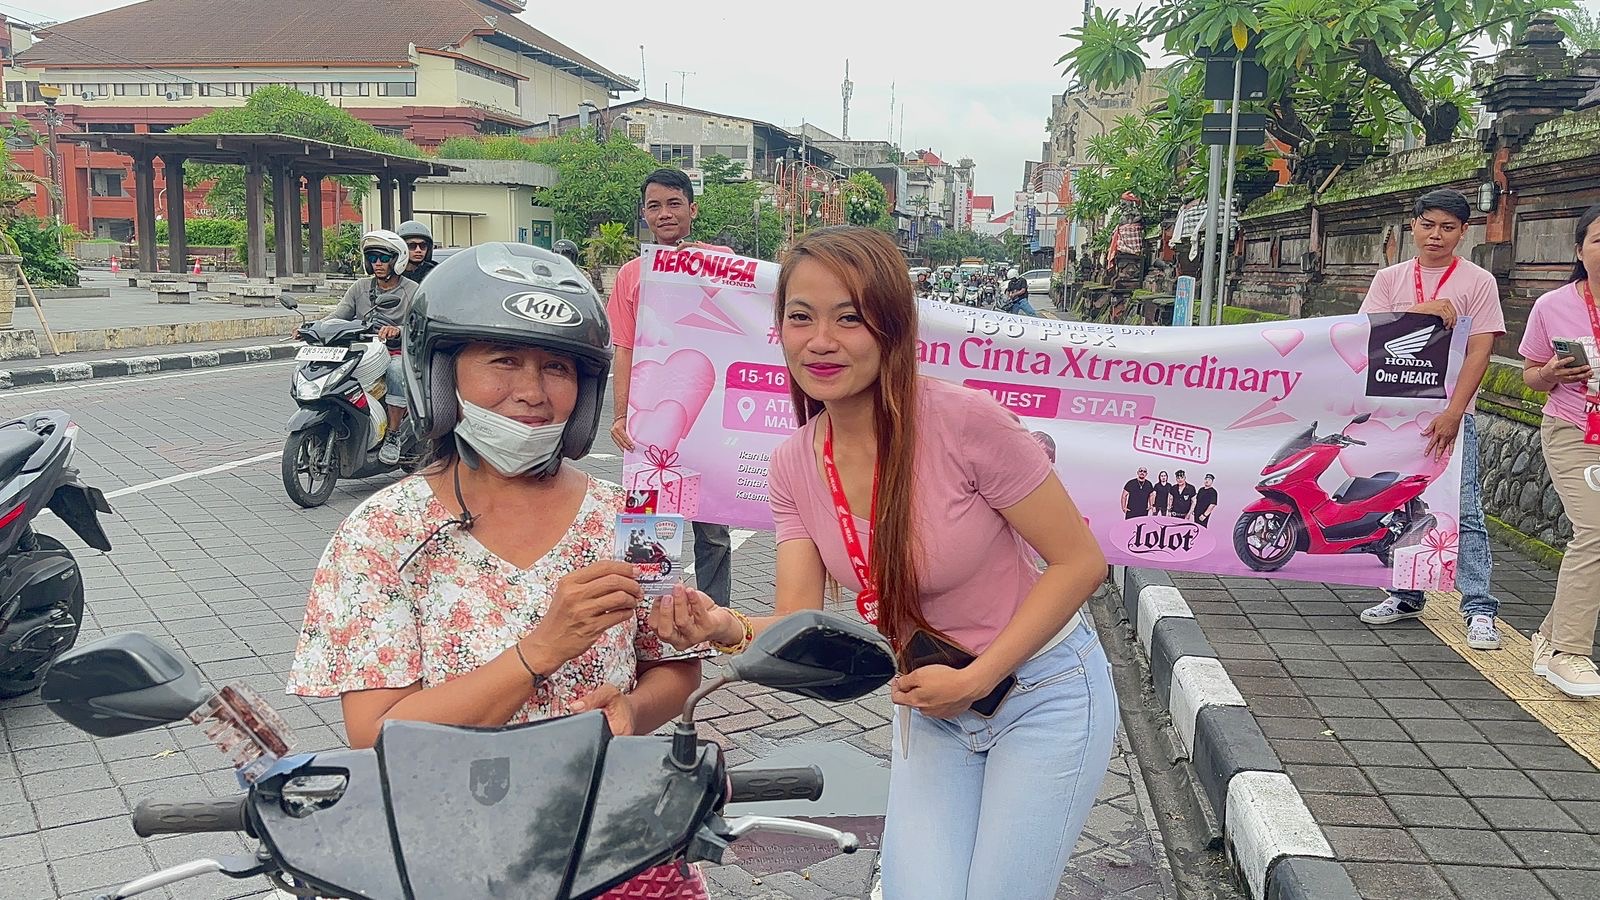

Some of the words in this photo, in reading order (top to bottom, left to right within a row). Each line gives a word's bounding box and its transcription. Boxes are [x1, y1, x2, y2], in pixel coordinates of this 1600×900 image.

[652, 249, 759, 283] HERONUSA
[721, 279, 757, 289] HONDA
[524, 297, 568, 320] Kyt
[931, 302, 987, 319] HAPPY
[992, 312, 1115, 335] VALENTINE'S
[1120, 327, 1157, 336] DAY
[966, 316, 1026, 339] 160
[1040, 327, 1118, 349] PCX
[915, 339, 951, 366] an
[958, 337, 1051, 376] Cinta
[1056, 347, 1303, 402] Xtraordinary
[1384, 357, 1434, 368] HONDA
[738, 368, 786, 386] 15-16
[1375, 369, 1399, 385] One
[1400, 370, 1440, 386] HEART.
[981, 389, 1047, 410] UEST
[1070, 396, 1138, 418] STAR
[1152, 423, 1197, 444] FREE
[1141, 438, 1203, 459] ENTRY!
[737, 477, 762, 488] Cinta
[1130, 522, 1197, 555] lolot
